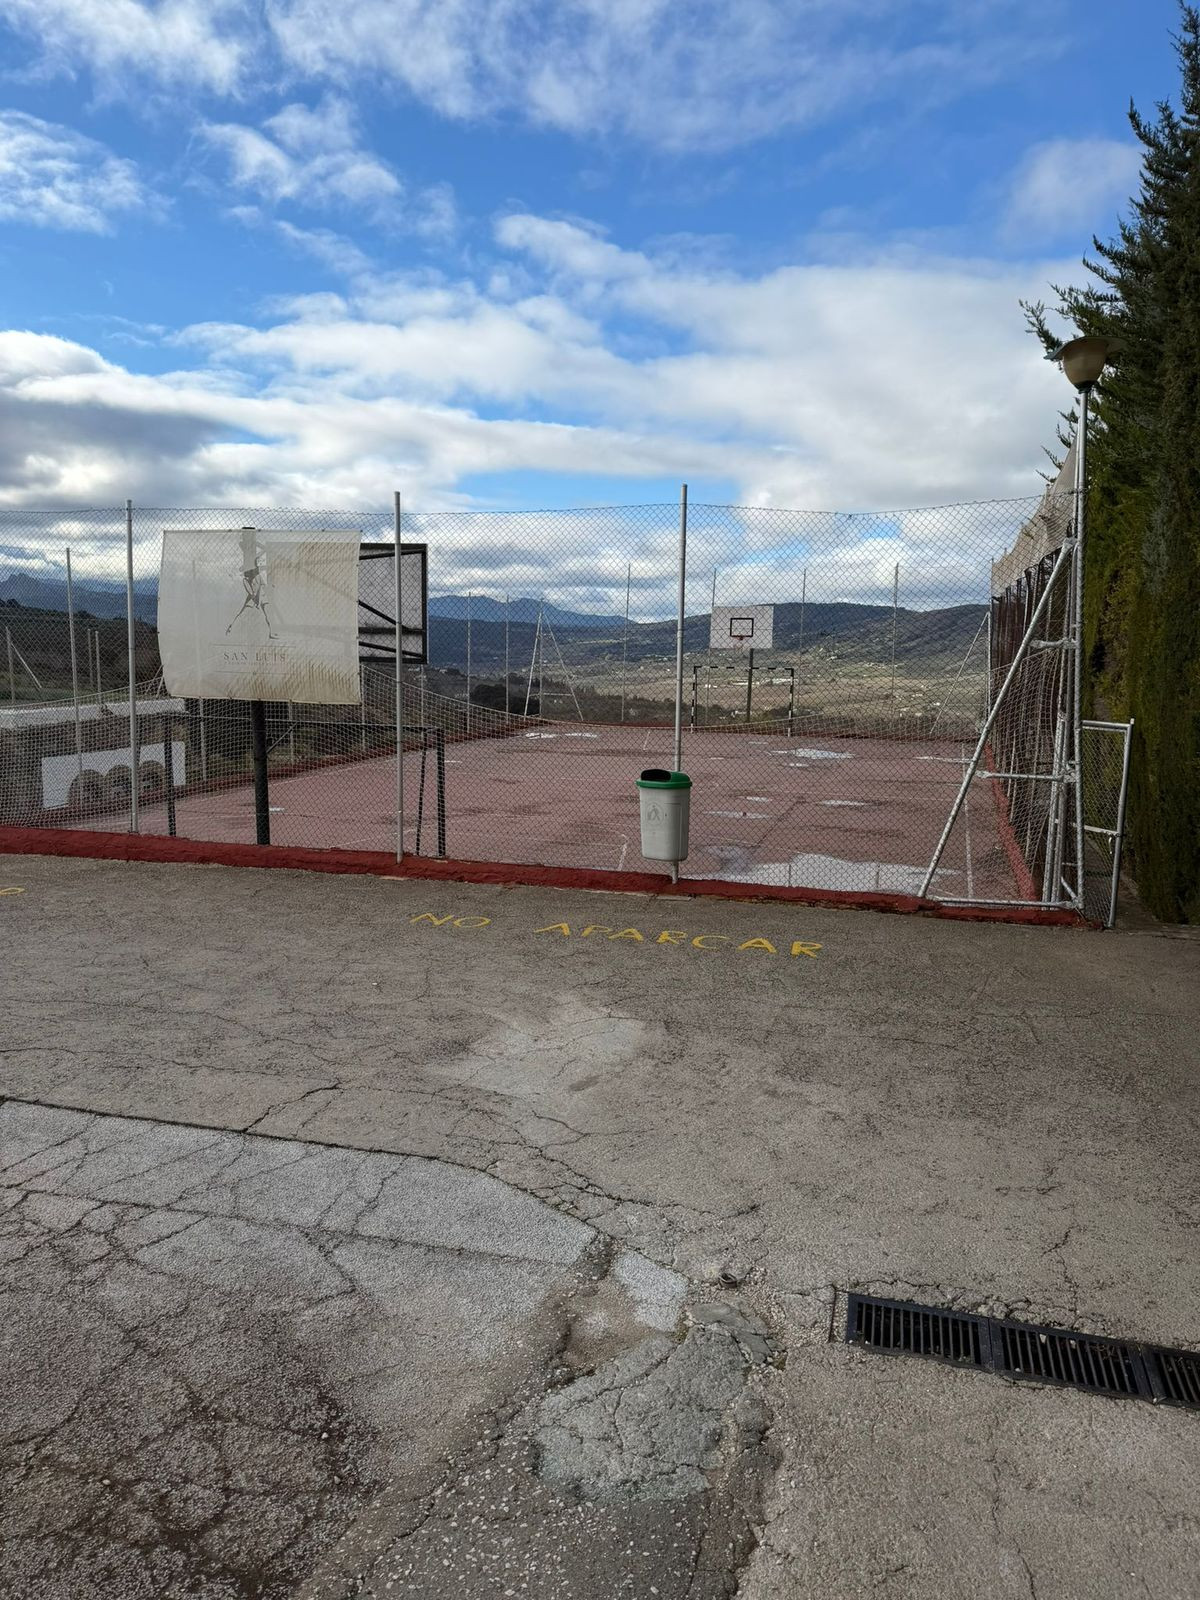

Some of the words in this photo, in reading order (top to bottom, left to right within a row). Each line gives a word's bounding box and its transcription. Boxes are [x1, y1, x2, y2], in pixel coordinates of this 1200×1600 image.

[223, 652, 248, 661] SAN
[255, 652, 286, 662] LUIS
[410, 912, 491, 928] NO
[534, 921, 823, 958] APARCAR
